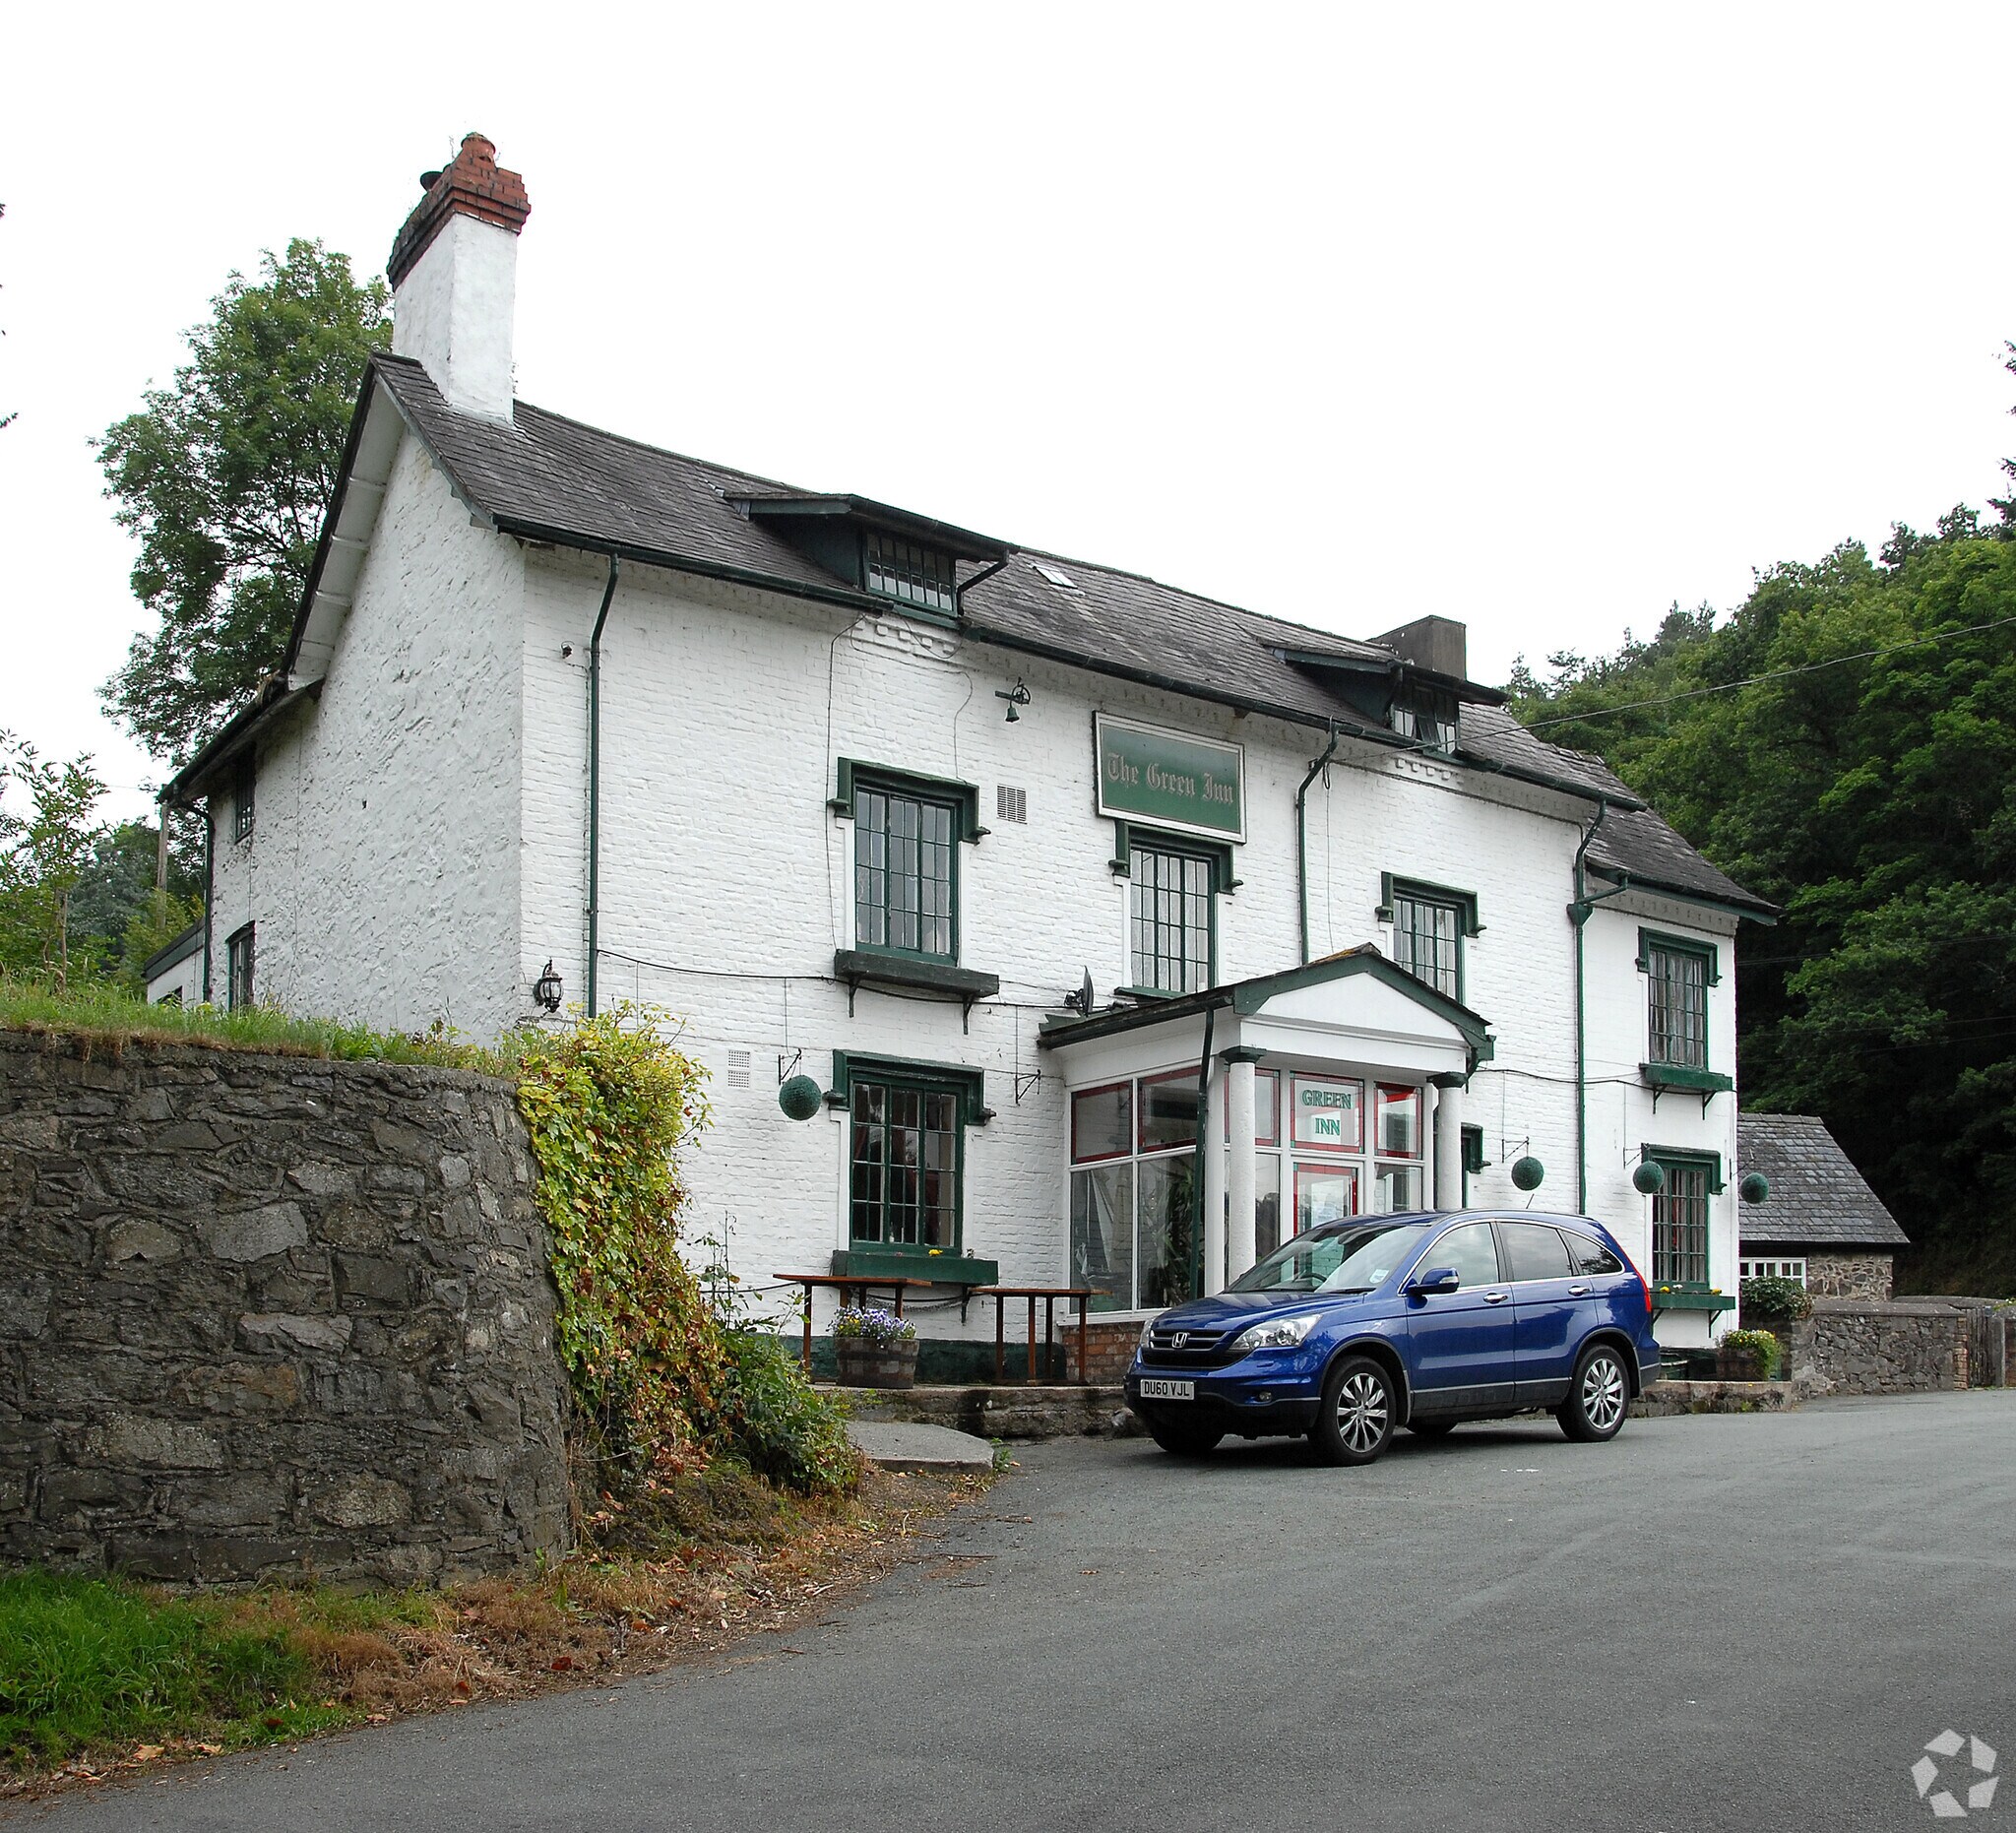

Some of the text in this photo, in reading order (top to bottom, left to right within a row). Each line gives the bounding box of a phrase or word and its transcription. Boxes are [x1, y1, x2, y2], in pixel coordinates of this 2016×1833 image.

[1107, 752, 1233, 804] The Green Inn
[1301, 1089, 1352, 1109] GREEN
[1315, 1117, 1341, 1136] INN
[1144, 1381, 1189, 1396] DU60 VJL
